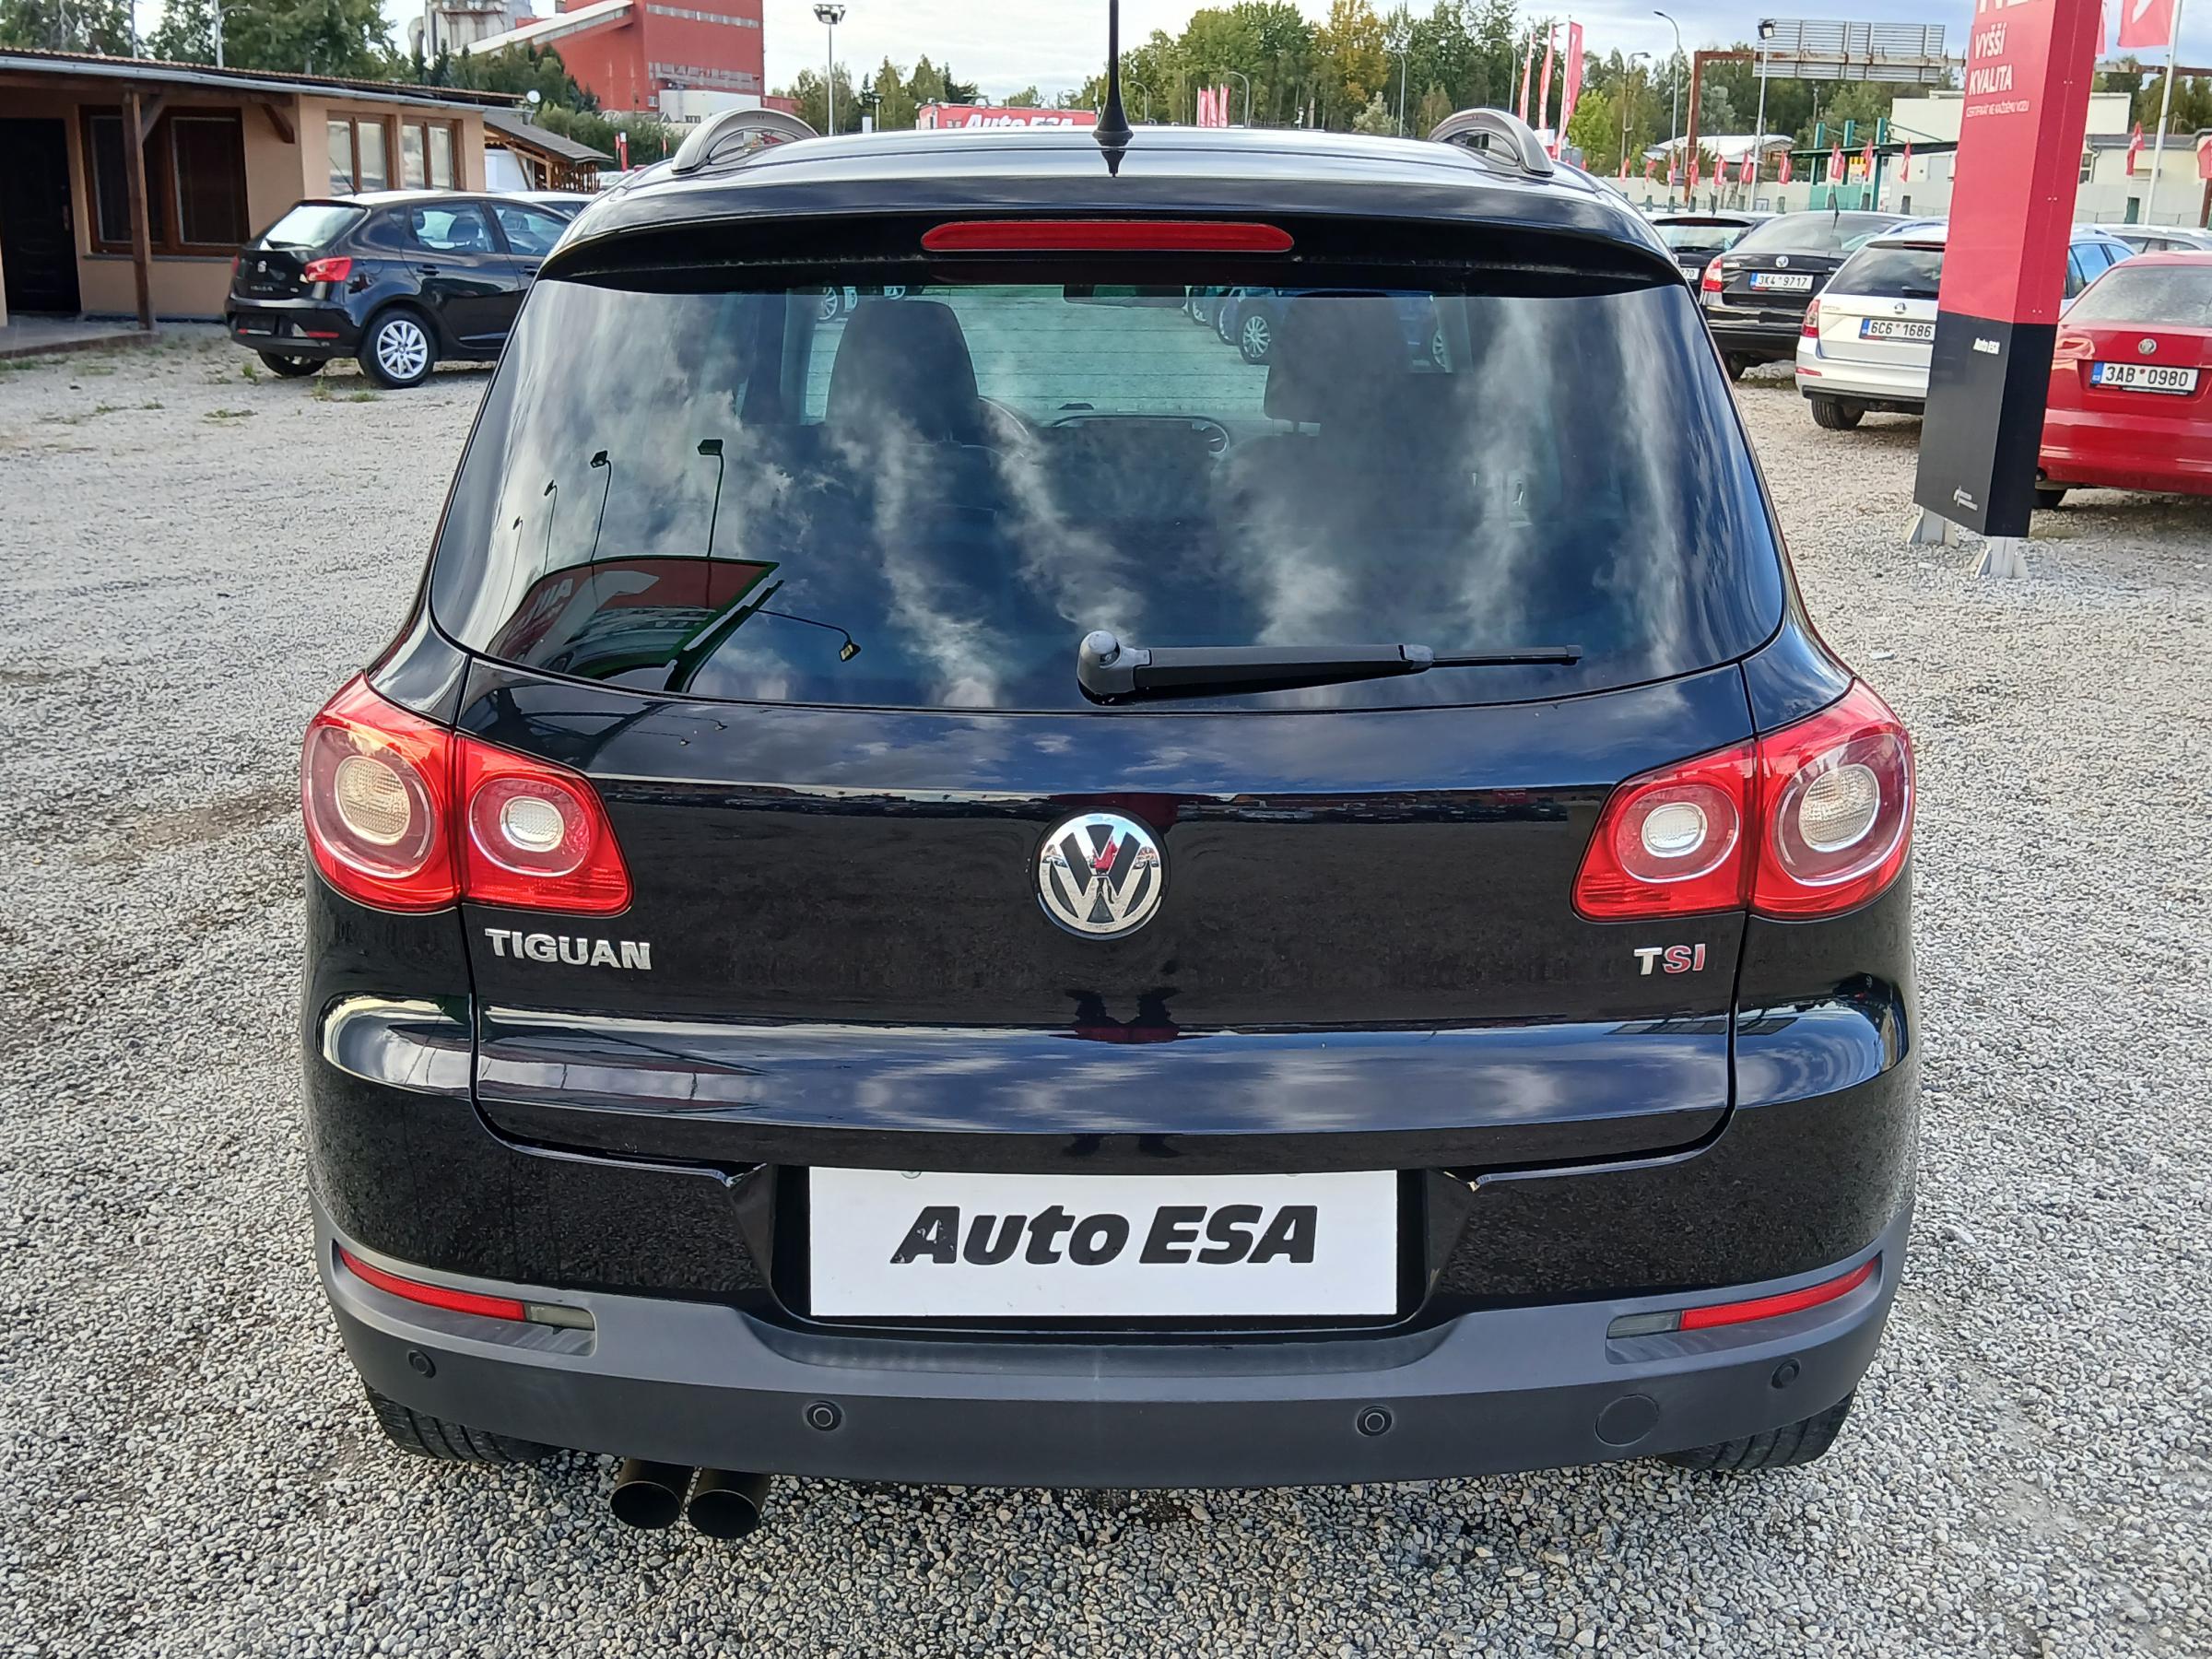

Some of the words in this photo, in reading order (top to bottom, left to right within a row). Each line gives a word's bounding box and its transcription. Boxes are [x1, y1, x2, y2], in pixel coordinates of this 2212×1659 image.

[1975, 22, 2006, 60] VYŠŠÍ
[1968, 65, 2013, 96] KVALITA
[1783, 276, 1807, 287] 9717
[1871, 322, 1893, 335] 6C6
[1903, 324, 1932, 337] 1686
[2105, 366, 2136, 382] 3AB
[2147, 369, 2189, 386] 0980
[485, 928, 652, 971] TIGUAN
[1634, 943, 1706, 975] TSI
[890, 1205, 1130, 1265] Auto
[1138, 1204, 1318, 1265] ESA
